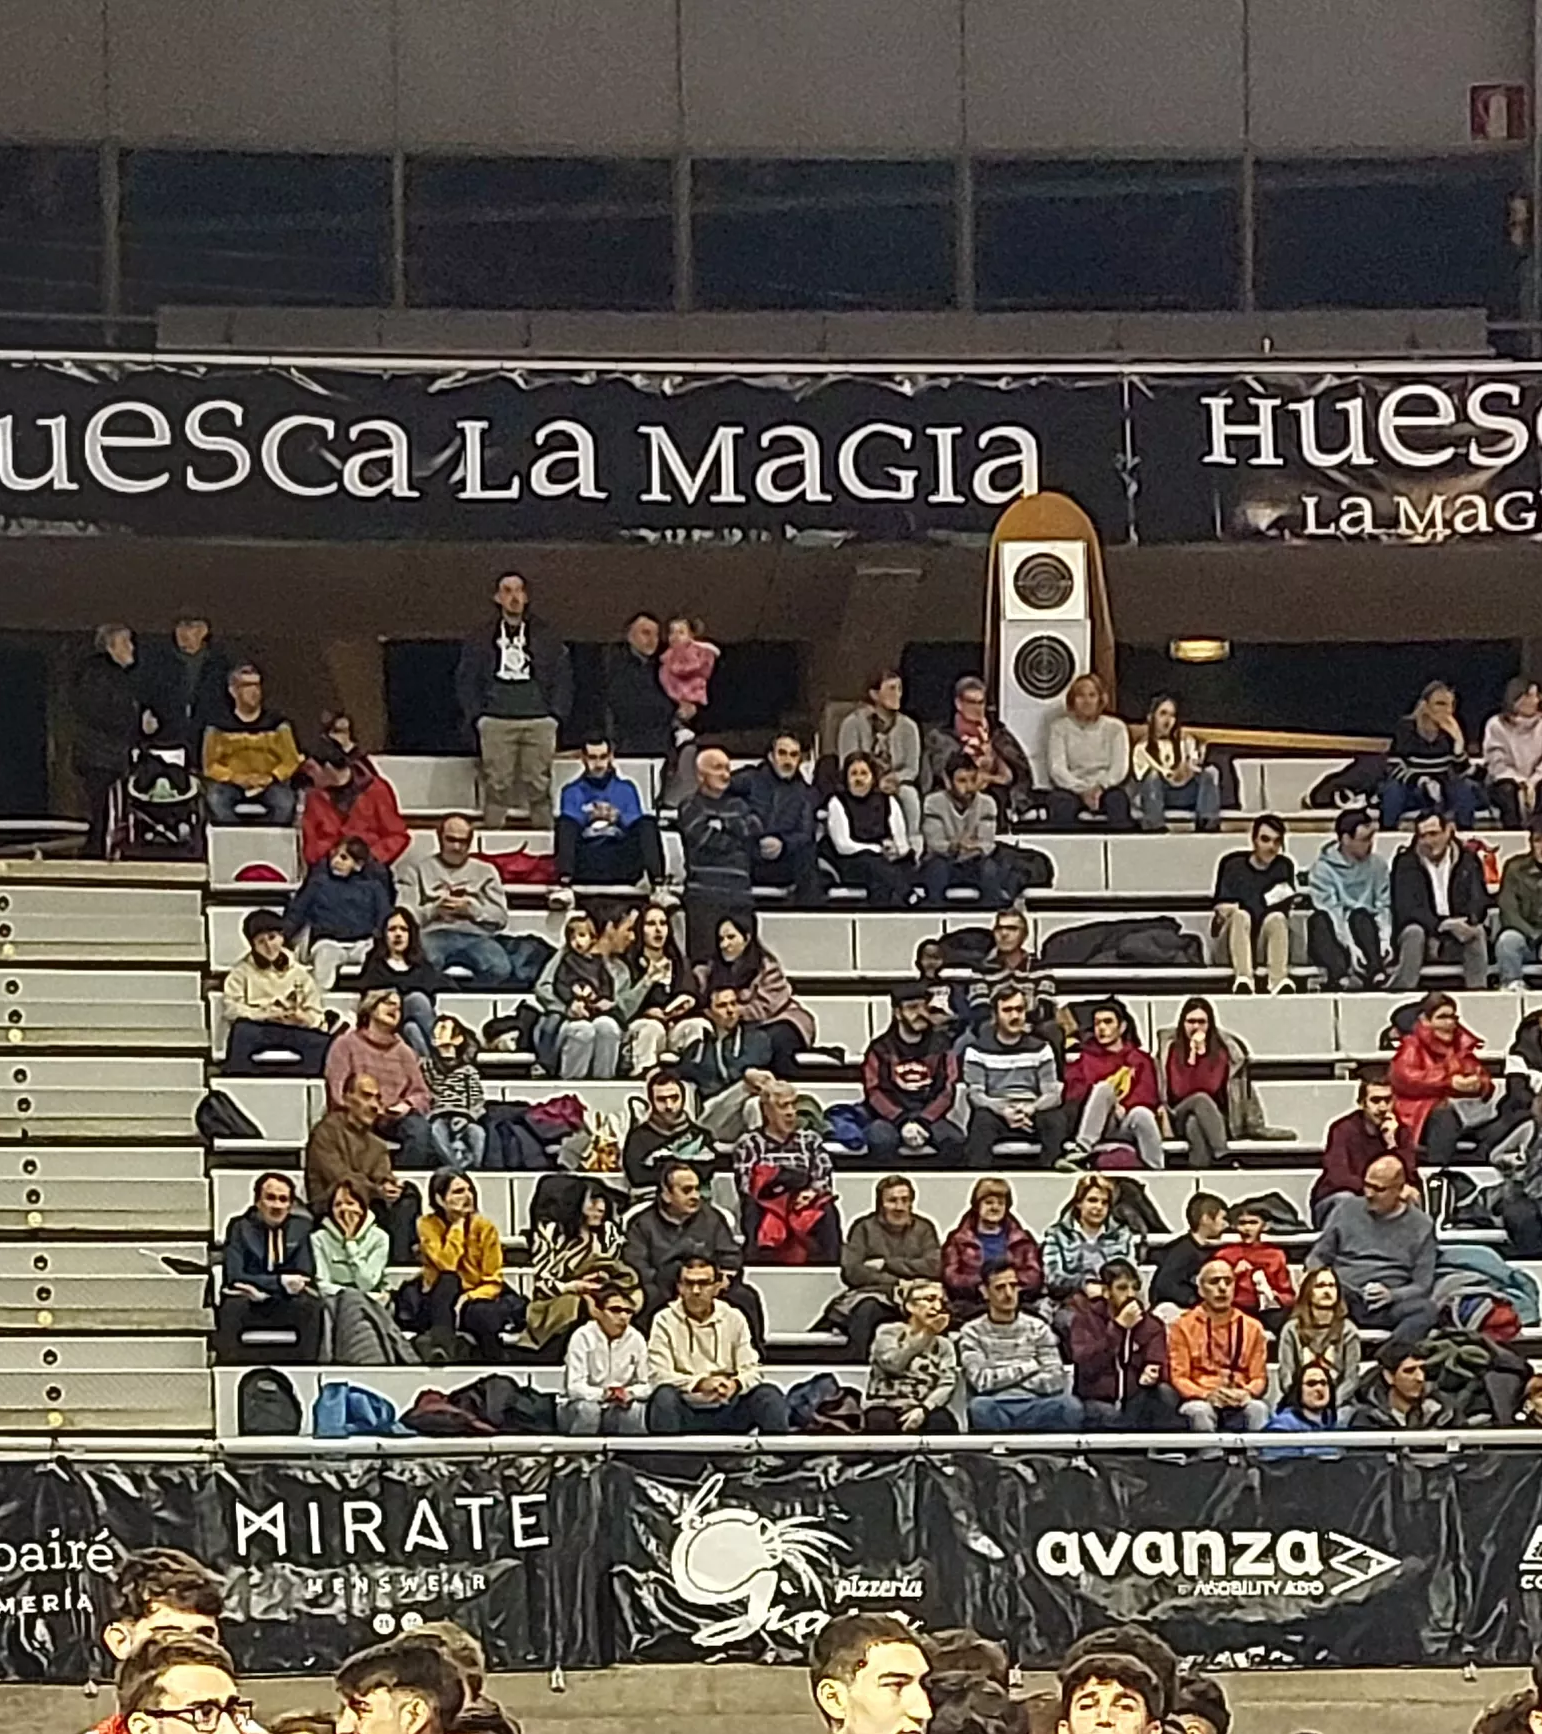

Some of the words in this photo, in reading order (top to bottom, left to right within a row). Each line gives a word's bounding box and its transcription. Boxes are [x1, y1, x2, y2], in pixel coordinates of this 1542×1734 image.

[455, 418, 609, 500] La
[1302, 490, 1377, 534] La
[236, 1493, 550, 1556] MIRATE
[1036, 1529, 1325, 1577] avanza
